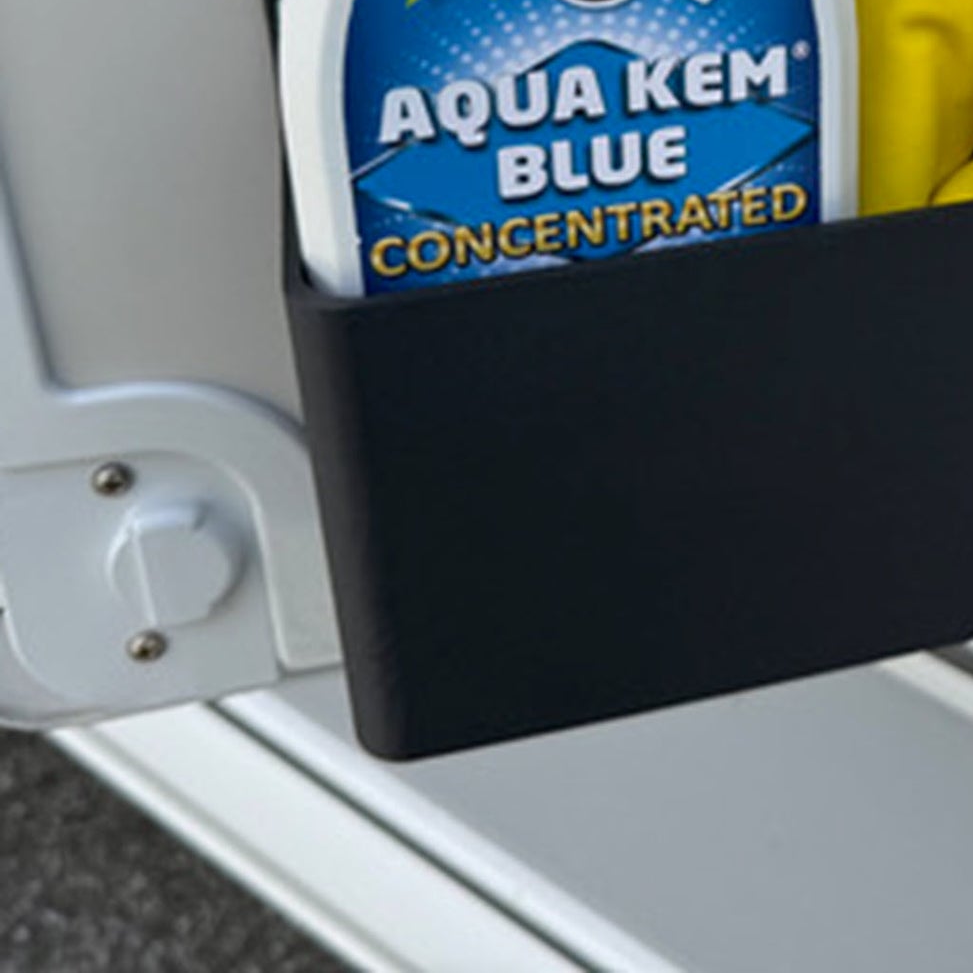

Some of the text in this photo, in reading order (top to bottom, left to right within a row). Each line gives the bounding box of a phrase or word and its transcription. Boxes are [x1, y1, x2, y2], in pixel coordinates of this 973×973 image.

[378, 65, 608, 149] AQUA
[496, 125, 688, 201] BLUE
[369, 183, 808, 278] CONCENTRATED
